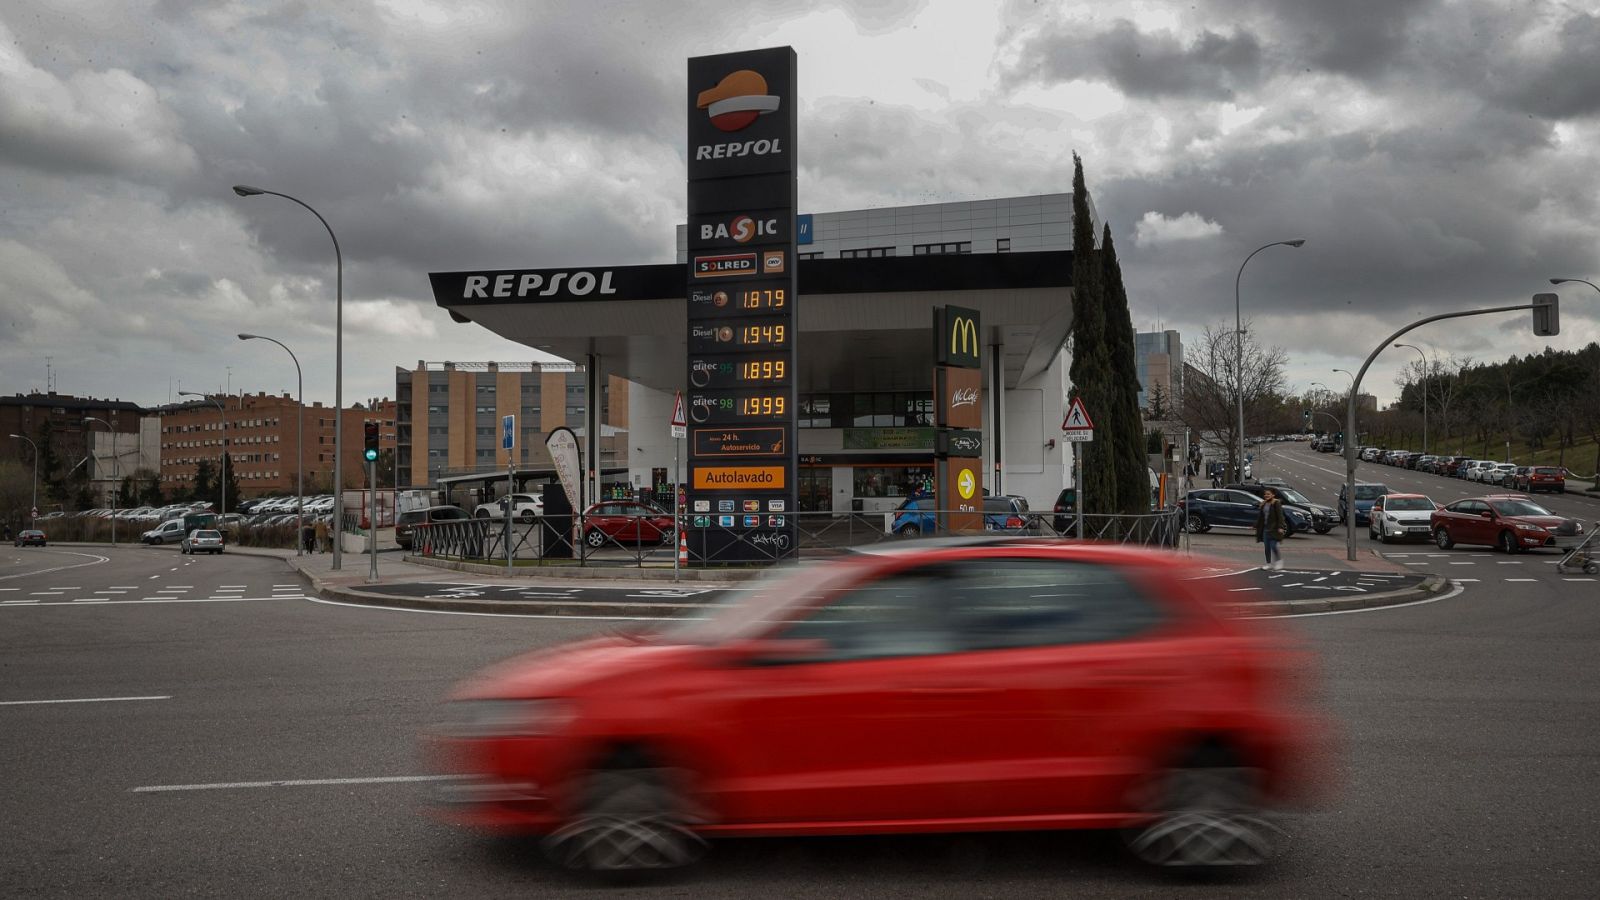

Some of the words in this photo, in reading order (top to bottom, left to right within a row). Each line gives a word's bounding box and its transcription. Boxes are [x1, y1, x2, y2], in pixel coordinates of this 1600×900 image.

[696, 138, 782, 161] REPSOL
[700, 218, 777, 241] BASIC
[701, 259, 750, 271] SOLRED
[463, 271, 617, 298] REPSOL
[692, 293, 713, 302] Diesel
[743, 289, 785, 309] 1.879
[692, 328, 713, 337] Diesel
[743, 325, 785, 344] 1.949
[692, 362, 718, 371] efitec
[743, 360, 785, 379] 1.899
[692, 398, 718, 406] efitec
[719, 398, 733, 409] 98
[743, 396, 785, 415] 1.999
[722, 433, 731, 441] 24
[732, 433, 740, 441] h.
[721, 443, 761, 451] Autoservicio
[705, 470, 773, 484] Autolavado
